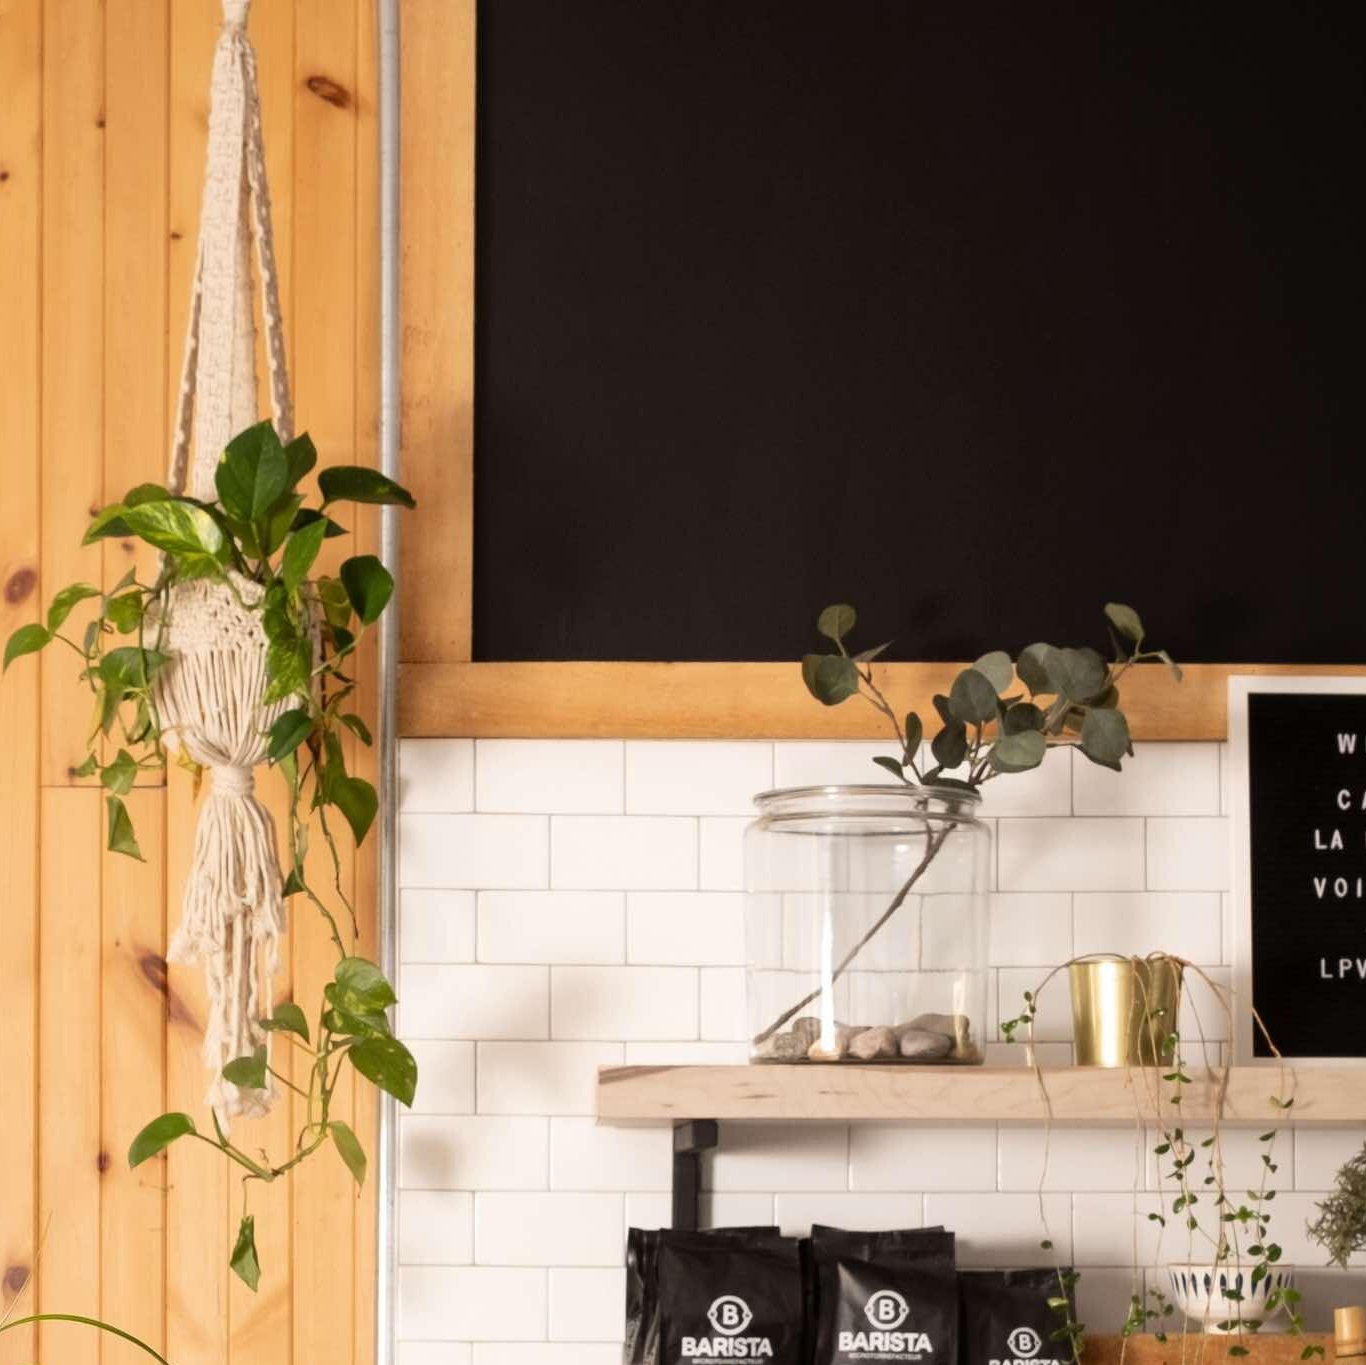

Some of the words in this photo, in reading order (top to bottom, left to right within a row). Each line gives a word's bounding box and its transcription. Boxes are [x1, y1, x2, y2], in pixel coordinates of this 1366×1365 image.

[1314, 829, 1344, 850] LA
[722, 1304, 739, 1326] B
[878, 1298, 895, 1321] B
[681, 1336, 773, 1357] BARISTA
[838, 1330, 933, 1354] BARISTA
[1019, 1334, 1032, 1351] B
